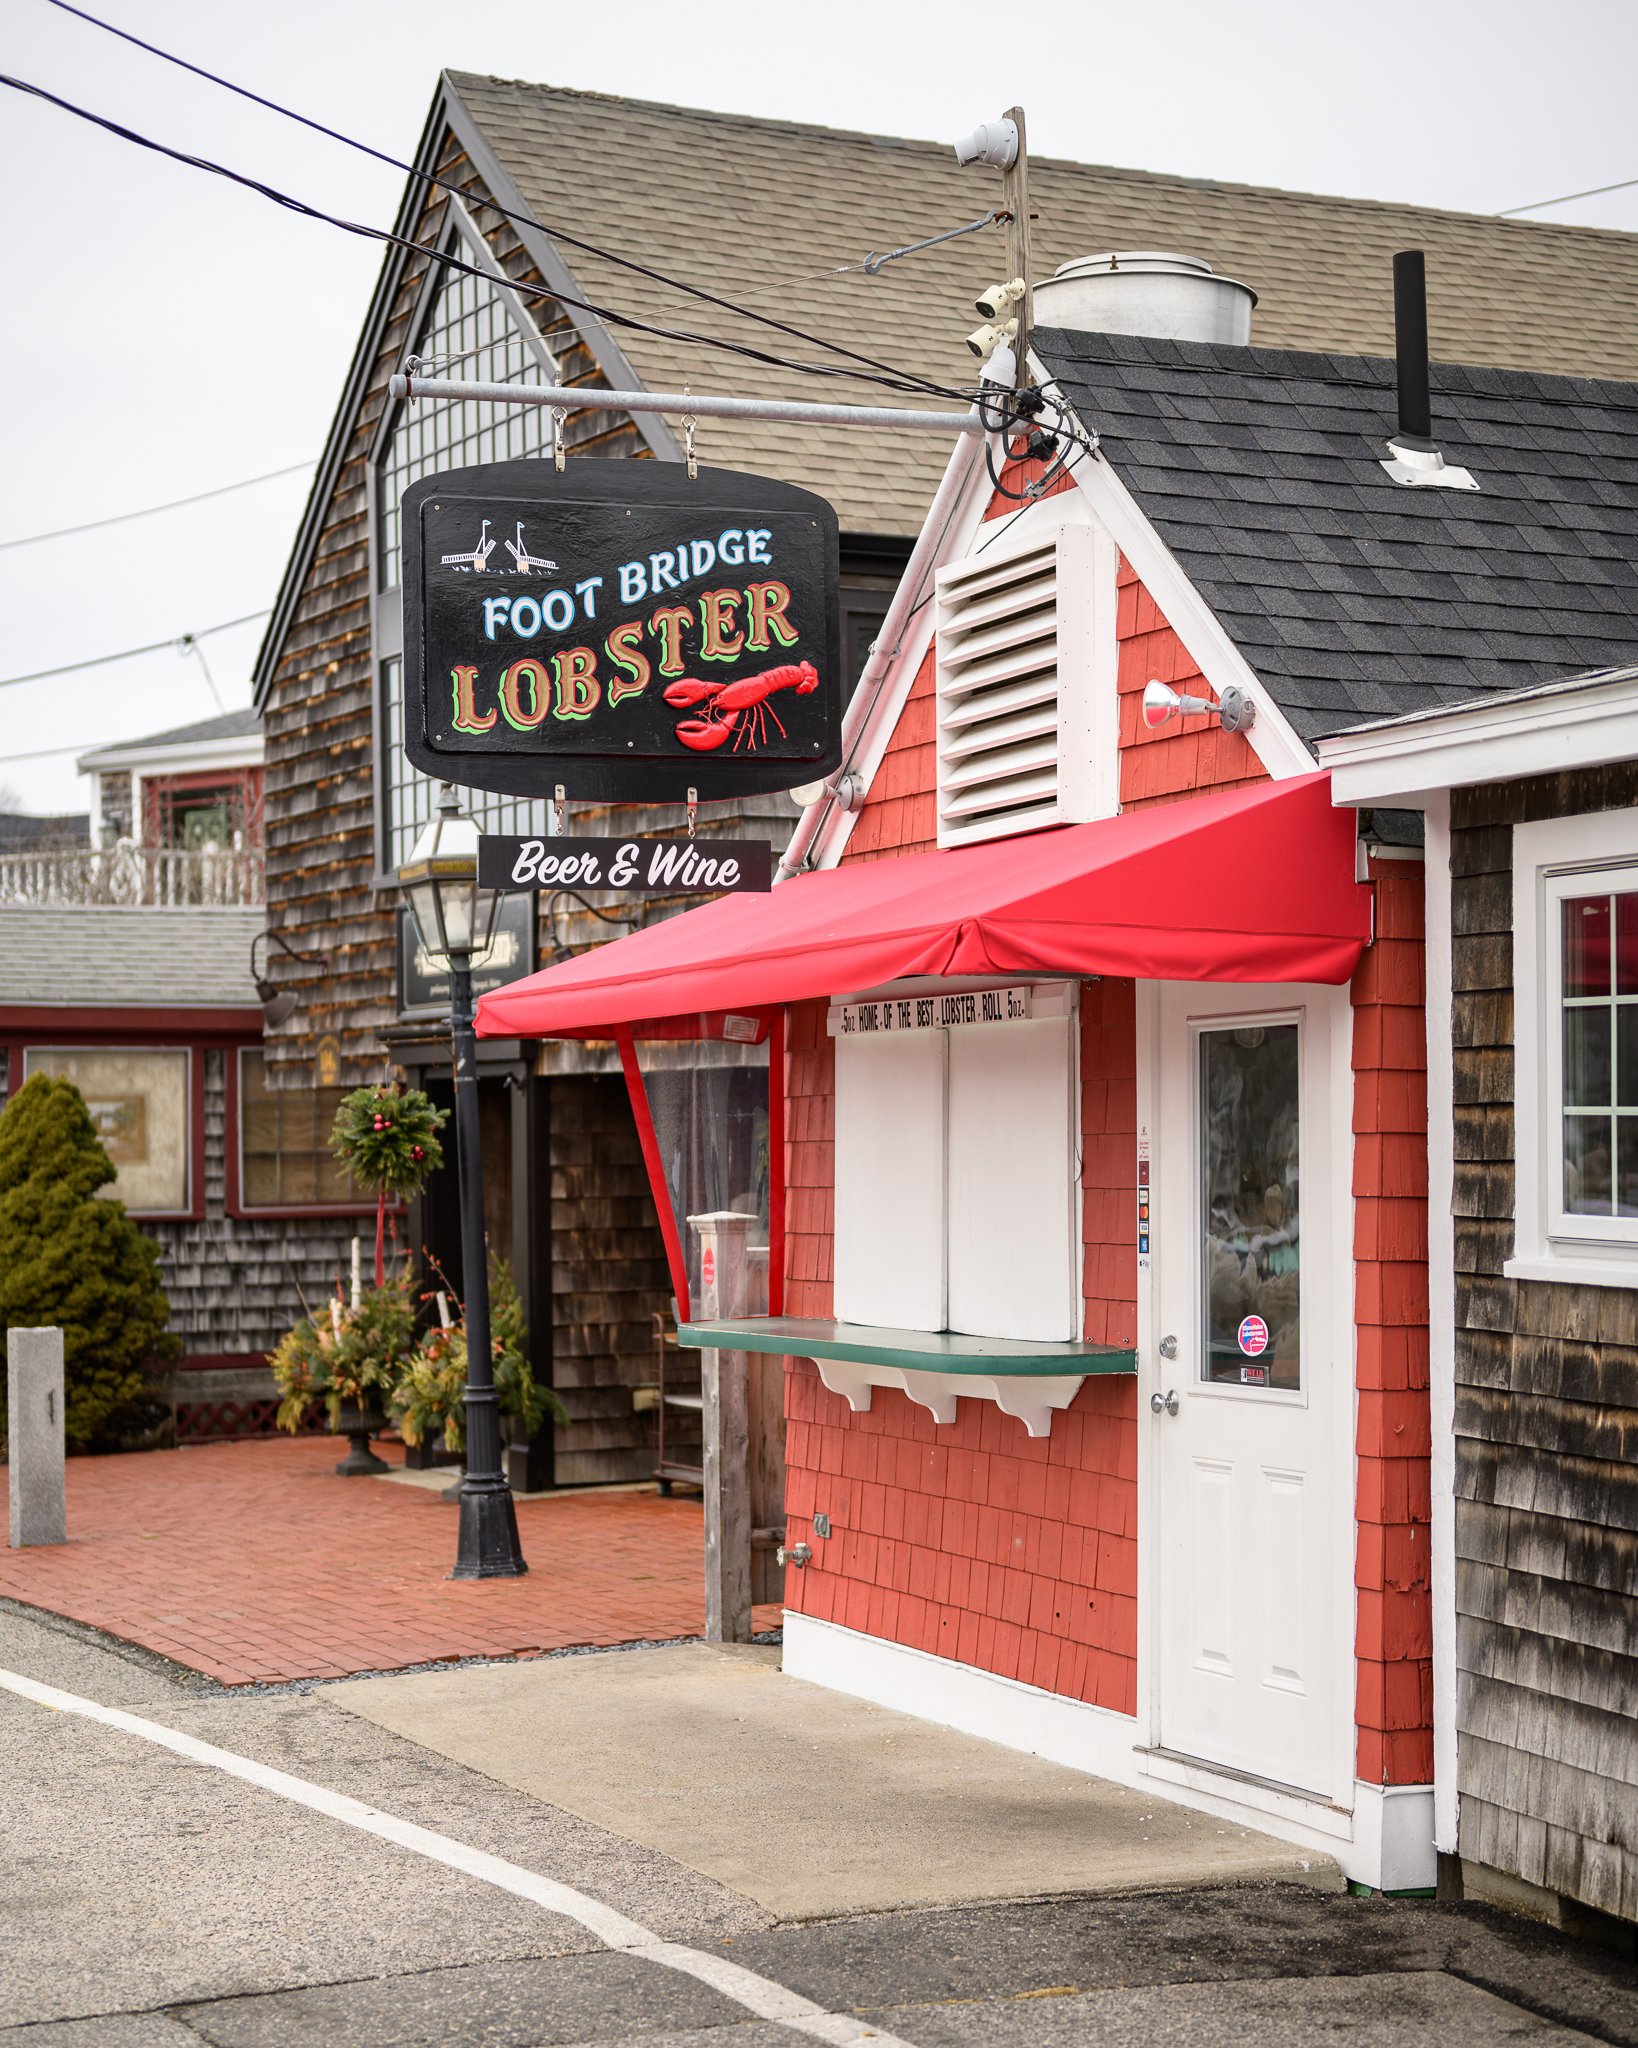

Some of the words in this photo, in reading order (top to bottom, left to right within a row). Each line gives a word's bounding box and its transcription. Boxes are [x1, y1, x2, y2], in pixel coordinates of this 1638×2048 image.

[481, 575, 603, 642] FOOT
[616, 528, 773, 605] BRIDGE
[450, 580, 800, 736] LOBSTER
[510, 840, 602, 885] Beer
[607, 842, 641, 887] &
[647, 842, 742, 887] Wine
[858, 1004, 878, 1032] HOME
[883, 1003, 892, 1029] OF
[897, 1001, 911, 1028] THE
[916, 999, 934, 1027] BEST
[940, 995, 976, 1025] LOBSTER
[982, 992, 1002, 1021] ROLL
